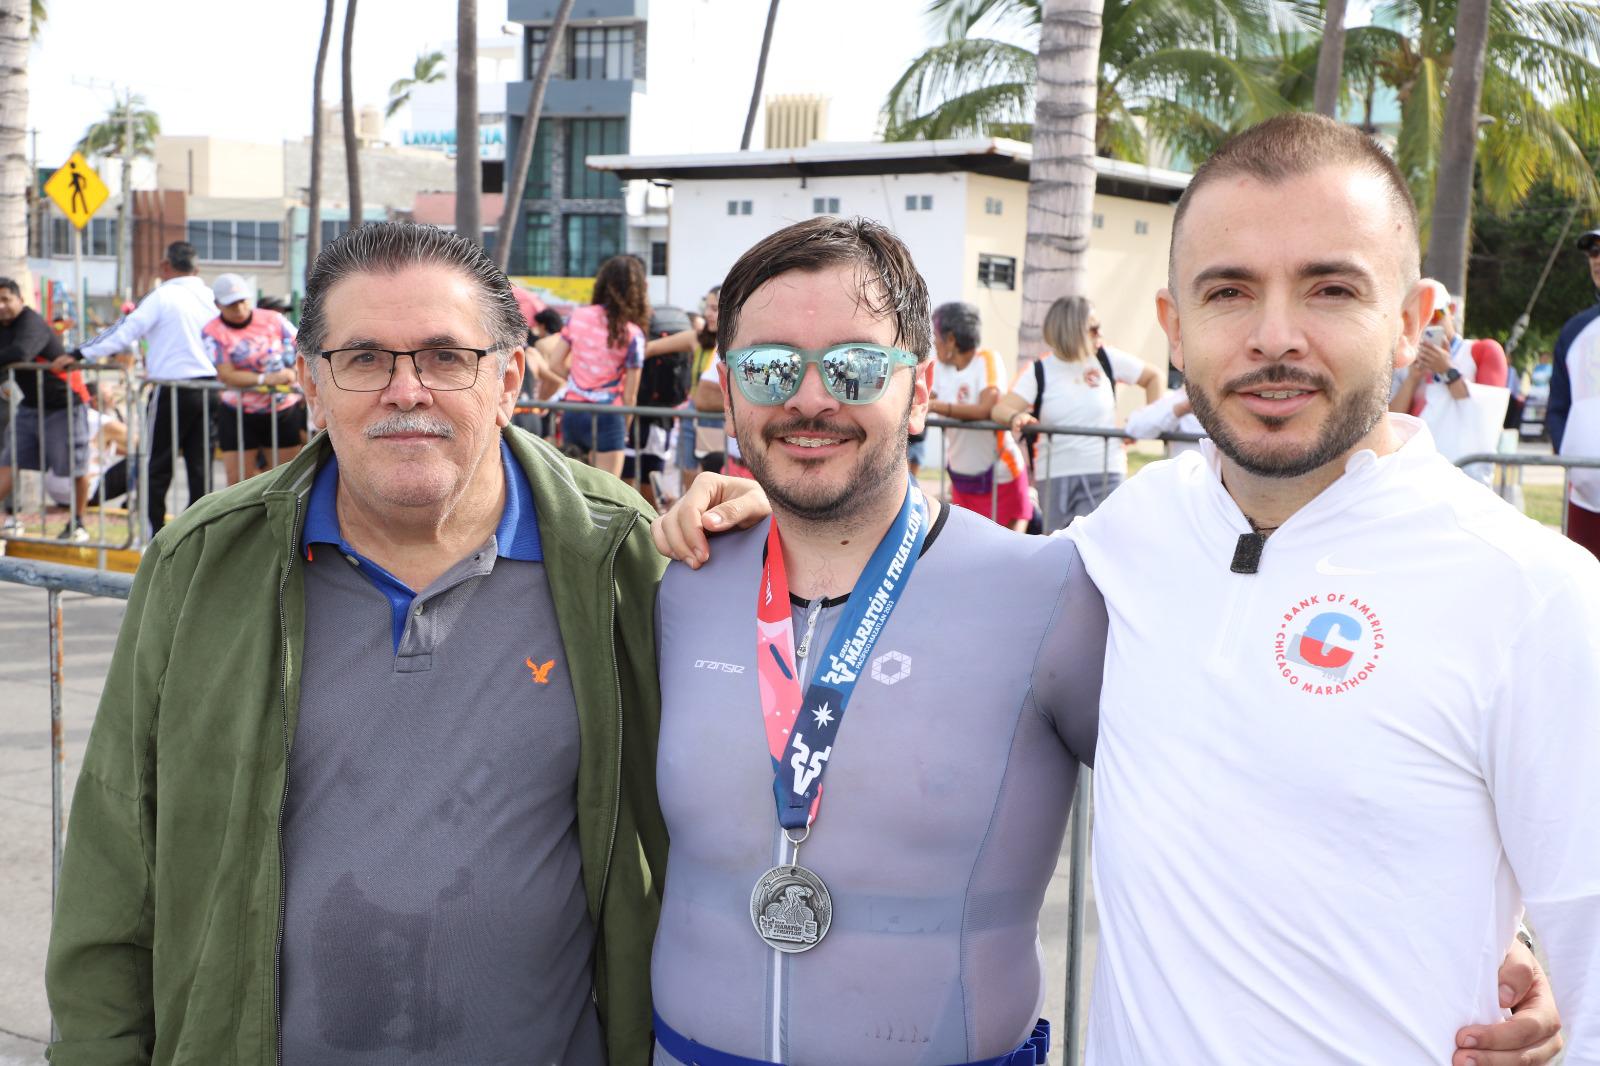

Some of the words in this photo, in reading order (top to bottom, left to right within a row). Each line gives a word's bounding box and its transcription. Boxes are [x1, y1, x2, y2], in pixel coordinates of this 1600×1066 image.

[839, 638, 852, 659] GRAN
[844, 586, 890, 667] MARATÓN
[883, 577, 895, 592] &
[1284, 595, 1320, 622] BANK
[1327, 593, 1346, 603] OF
[1350, 598, 1385, 650] AMERICA
[1275, 633, 1299, 685] CHICAGO
[1302, 662, 1377, 696] MARATHON
